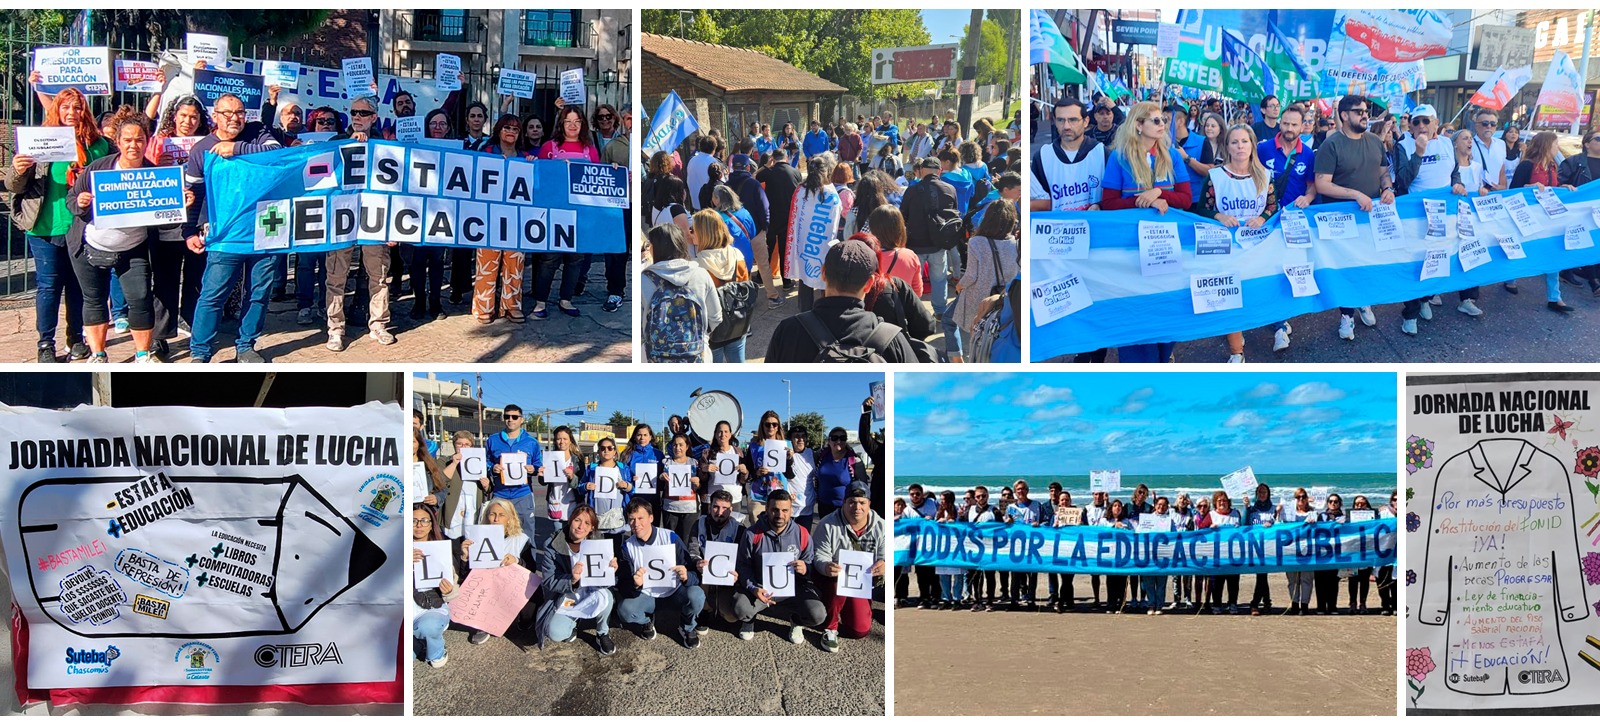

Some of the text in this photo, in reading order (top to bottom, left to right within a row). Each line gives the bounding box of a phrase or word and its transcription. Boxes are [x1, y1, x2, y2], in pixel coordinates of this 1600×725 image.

[60, 66, 83, 74] PARA
[1328, 69, 1339, 77] EN
[1341, 71, 1378, 82] DEFENSA
[48, 74, 97, 83] EDUCACIÓN
[214, 77, 245, 87] FONDOS
[194, 83, 262, 96] NACIONALES PARA
[120, 172, 156, 181] NO A LA
[584, 166, 613, 177] NO AL
[98, 177, 178, 193] CRIMINALIZACIÓN
[581, 175, 616, 187] AJUSTE
[127, 190, 152, 199] DE LA
[573, 183, 625, 197] EDUCATIVO
[99, 197, 180, 211] PROTESTA SOCIAL
[155, 209, 182, 219] CTERA
[1036, 225, 1087, 235] NO AJUSTE
[1032, 277, 1080, 299] NO AJUSTE
[1196, 276, 1234, 288] URGENTE
[1217, 287, 1239, 297] FONID
[1413, 390, 1591, 415] JORNADA NACIONAL
[1459, 412, 1545, 434] DE LUCHA
[9, 434, 400, 470] JORNADA NACIONAL DE LUCHA
[1441, 491, 1566, 517] Por más presupuesto
[1440, 515, 1562, 535] Restitución del FONID
[211, 530, 267, 553] LA EDUCACIÓN NECESITA
[905, 525, 985, 564] TODXS
[992, 530, 1045, 564] POR
[1052, 533, 1088, 567] LA
[1473, 534, 1506, 553] ¡YA!
[128, 553, 182, 583] BASTA DE
[1459, 553, 1550, 572] Aumento de las
[63, 567, 95, 591] ¡DEVOLVÉ
[1464, 575, 1495, 586] becas
[61, 591, 77, 603] LOS
[64, 583, 119, 614] QUE SACASTE DEL
[137, 597, 167, 611] ¡BASTA
[1464, 590, 1484, 607] Ley
[1487, 591, 1497, 601] de
[71, 592, 124, 621] SUELDO DOCENTE
[137, 604, 164, 617] MILEI!
[1462, 603, 1542, 613] miento educativo
[1510, 615, 1524, 624] DEL
[1471, 622, 1543, 635] salarial nacional
[66, 647, 106, 666] Suteba
[254, 642, 343, 669] CTERA
[67, 664, 110, 675] Chascomús
[1518, 668, 1565, 684] CTERA
[1463, 674, 1484, 684] Suteba
